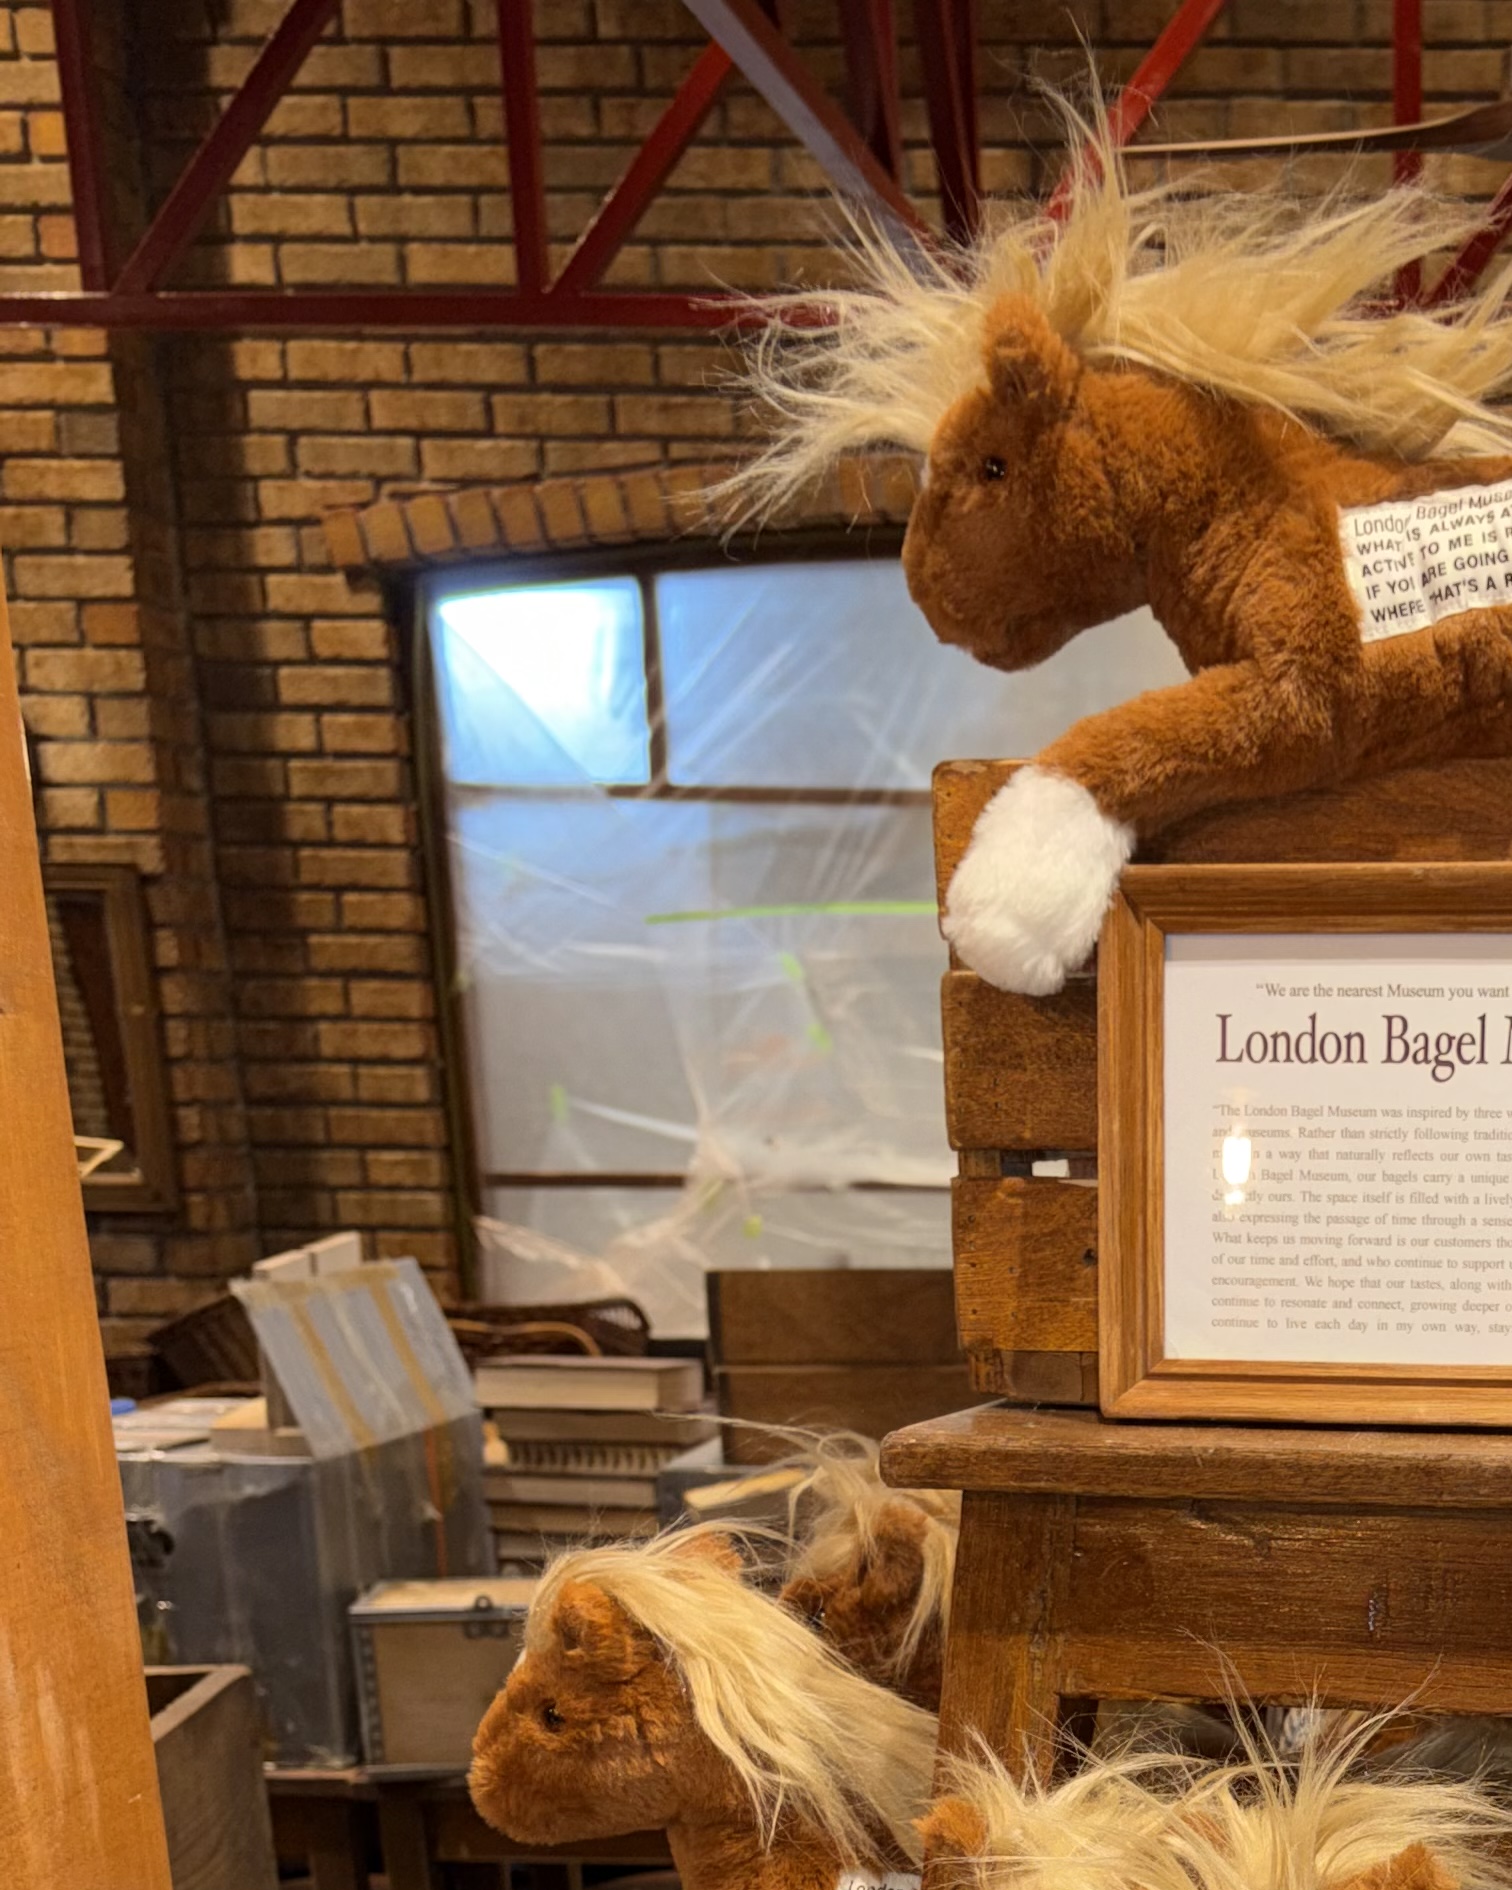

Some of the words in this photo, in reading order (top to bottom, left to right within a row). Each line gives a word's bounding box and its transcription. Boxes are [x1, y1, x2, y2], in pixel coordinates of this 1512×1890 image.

[1416, 498, 1463, 520] Bagel
[1356, 537, 1402, 555] WHAT
[1406, 527, 1421, 541] IS
[1429, 510, 1495, 535] ALWAYS
[1420, 541, 1439, 560] TO
[1448, 534, 1473, 551] ME
[1482, 530, 1498, 544] IS
[1366, 584, 1381, 600] IF
[1421, 561, 1447, 587] ARE
[1453, 548, 1509, 571] GOING
[1486, 575, 1497, 591] A
[1289, 987, 1310, 997] are
[1313, 983, 1334, 997] the
[1336, 985, 1384, 997] nearest
[1387, 983, 1445, 998] Museum
[1448, 987, 1474, 1001] you
[1477, 986, 1510, 998] want
[1215, 1012, 1368, 1064] London
[1381, 1013, 1489, 1083] Bagel
[1244, 1105, 1288, 1116] London
[1291, 1105, 1324, 1120] Bagel
[1328, 1106, 1378, 1117] Museum
[1381, 1109, 1403, 1118] was
[1407, 1106, 1452, 1121] inspired
[1456, 1106, 1470, 1121] by
[1474, 1107, 1503, 1119] three
[1298, 1127, 1336, 1138] Rather
[1341, 1127, 1365, 1139] than
[1370, 1127, 1408, 1142] strictly
[1414, 1128, 1469, 1143] following
[1265, 1151, 1273, 1159] a
[1278, 1151, 1302, 1163] way
[1308, 1148, 1330, 1160] that
[1336, 1149, 1386, 1163] naturally
[1392, 1149, 1434, 1161] reflects
[1440, 1153, 1460, 1162] our
[1465, 1153, 1491, 1162] own
[1261, 1169, 1293, 1184] Bagel
[1357, 1173, 1376, 1182] our
[1382, 1170, 1417, 1185] bagels
[1423, 1174, 1452, 1185] carry
[1458, 1174, 1464, 1183] a
[1471, 1175, 1509, 1186] unique
[1300, 1191, 1322, 1202] The
[1328, 1194, 1356, 1205] space
[1363, 1192, 1392, 1203] itself
[1396, 1192, 1404, 1203] is
[1410, 1192, 1438, 1204] filled
[1444, 1193, 1468, 1204] with
[1239, 1213, 1299, 1227] expressing
[1304, 1212, 1321, 1224] the
[1326, 1215, 1370, 1227] passage
[1375, 1213, 1388, 1225] of
[1392, 1215, 1417, 1225] time
[1422, 1213, 1466, 1229] through
[1471, 1217, 1477, 1226] a
[1482, 1218, 1512, 1227] sense
[1212, 1232, 1242, 1244] What
[1246, 1232, 1278, 1247] keeps
[1283, 1236, 1296, 1244] us
[1299, 1236, 1343, 1248] moving
[1348, 1234, 1392, 1246] forward
[1397, 1238, 1406, 1246] is
[1410, 1237, 1430, 1247] our
[1433, 1237, 1492, 1248] customers
[1211, 1253, 1225, 1264] of
[1227, 1256, 1246, 1264] our
[1250, 1256, 1275, 1265] time
[1279, 1254, 1299, 1266] and
[1341, 1255, 1362, 1267] and
[1366, 1256, 1391, 1267] who
[1394, 1259, 1443, 1268] continue
[1447, 1259, 1458, 1268] to
[1462, 1260, 1505, 1272] support
